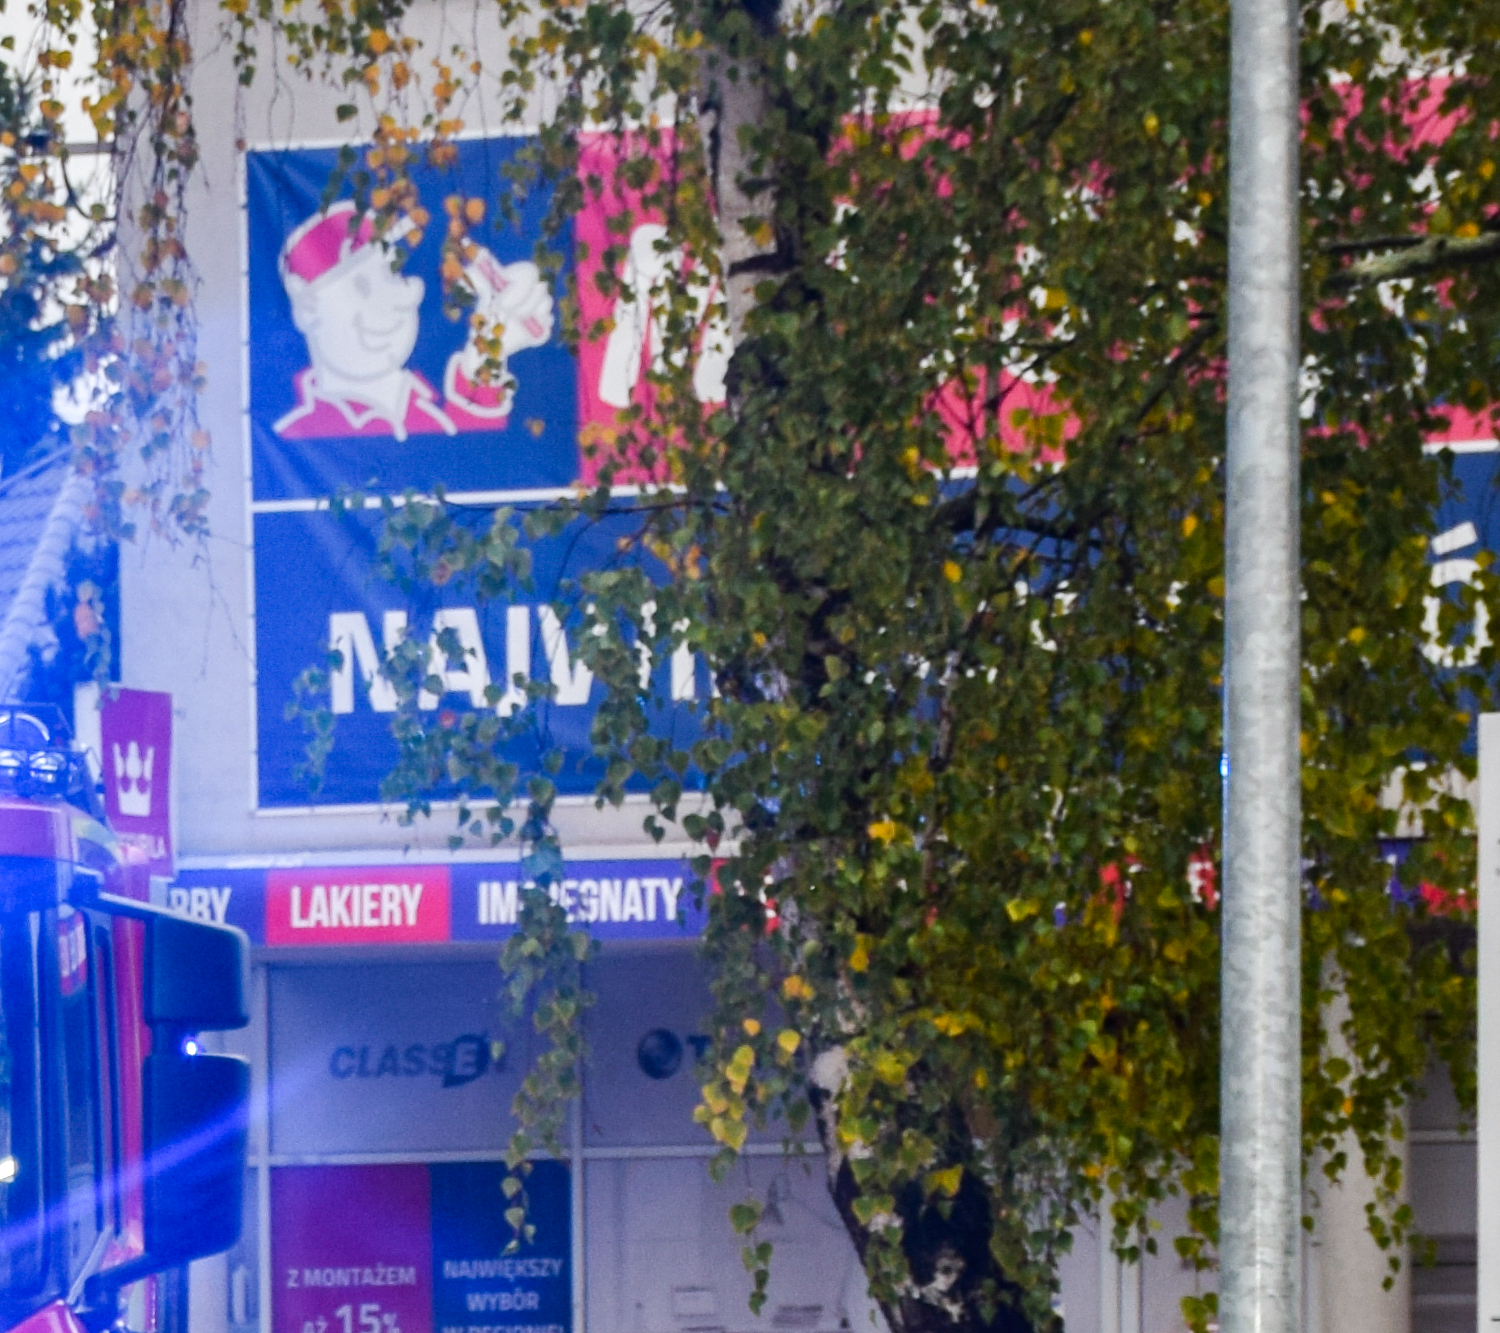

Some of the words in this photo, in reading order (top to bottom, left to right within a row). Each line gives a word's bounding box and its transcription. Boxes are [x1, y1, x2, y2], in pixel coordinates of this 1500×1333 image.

[291, 883, 423, 928] LAKIERY
[287, 1269, 299, 1288] Z
[304, 1262, 416, 1288] MONTAŻEM
[443, 1258, 563, 1281] NAJWIĘKSZY
[466, 1287, 539, 1311] WYBÓR
